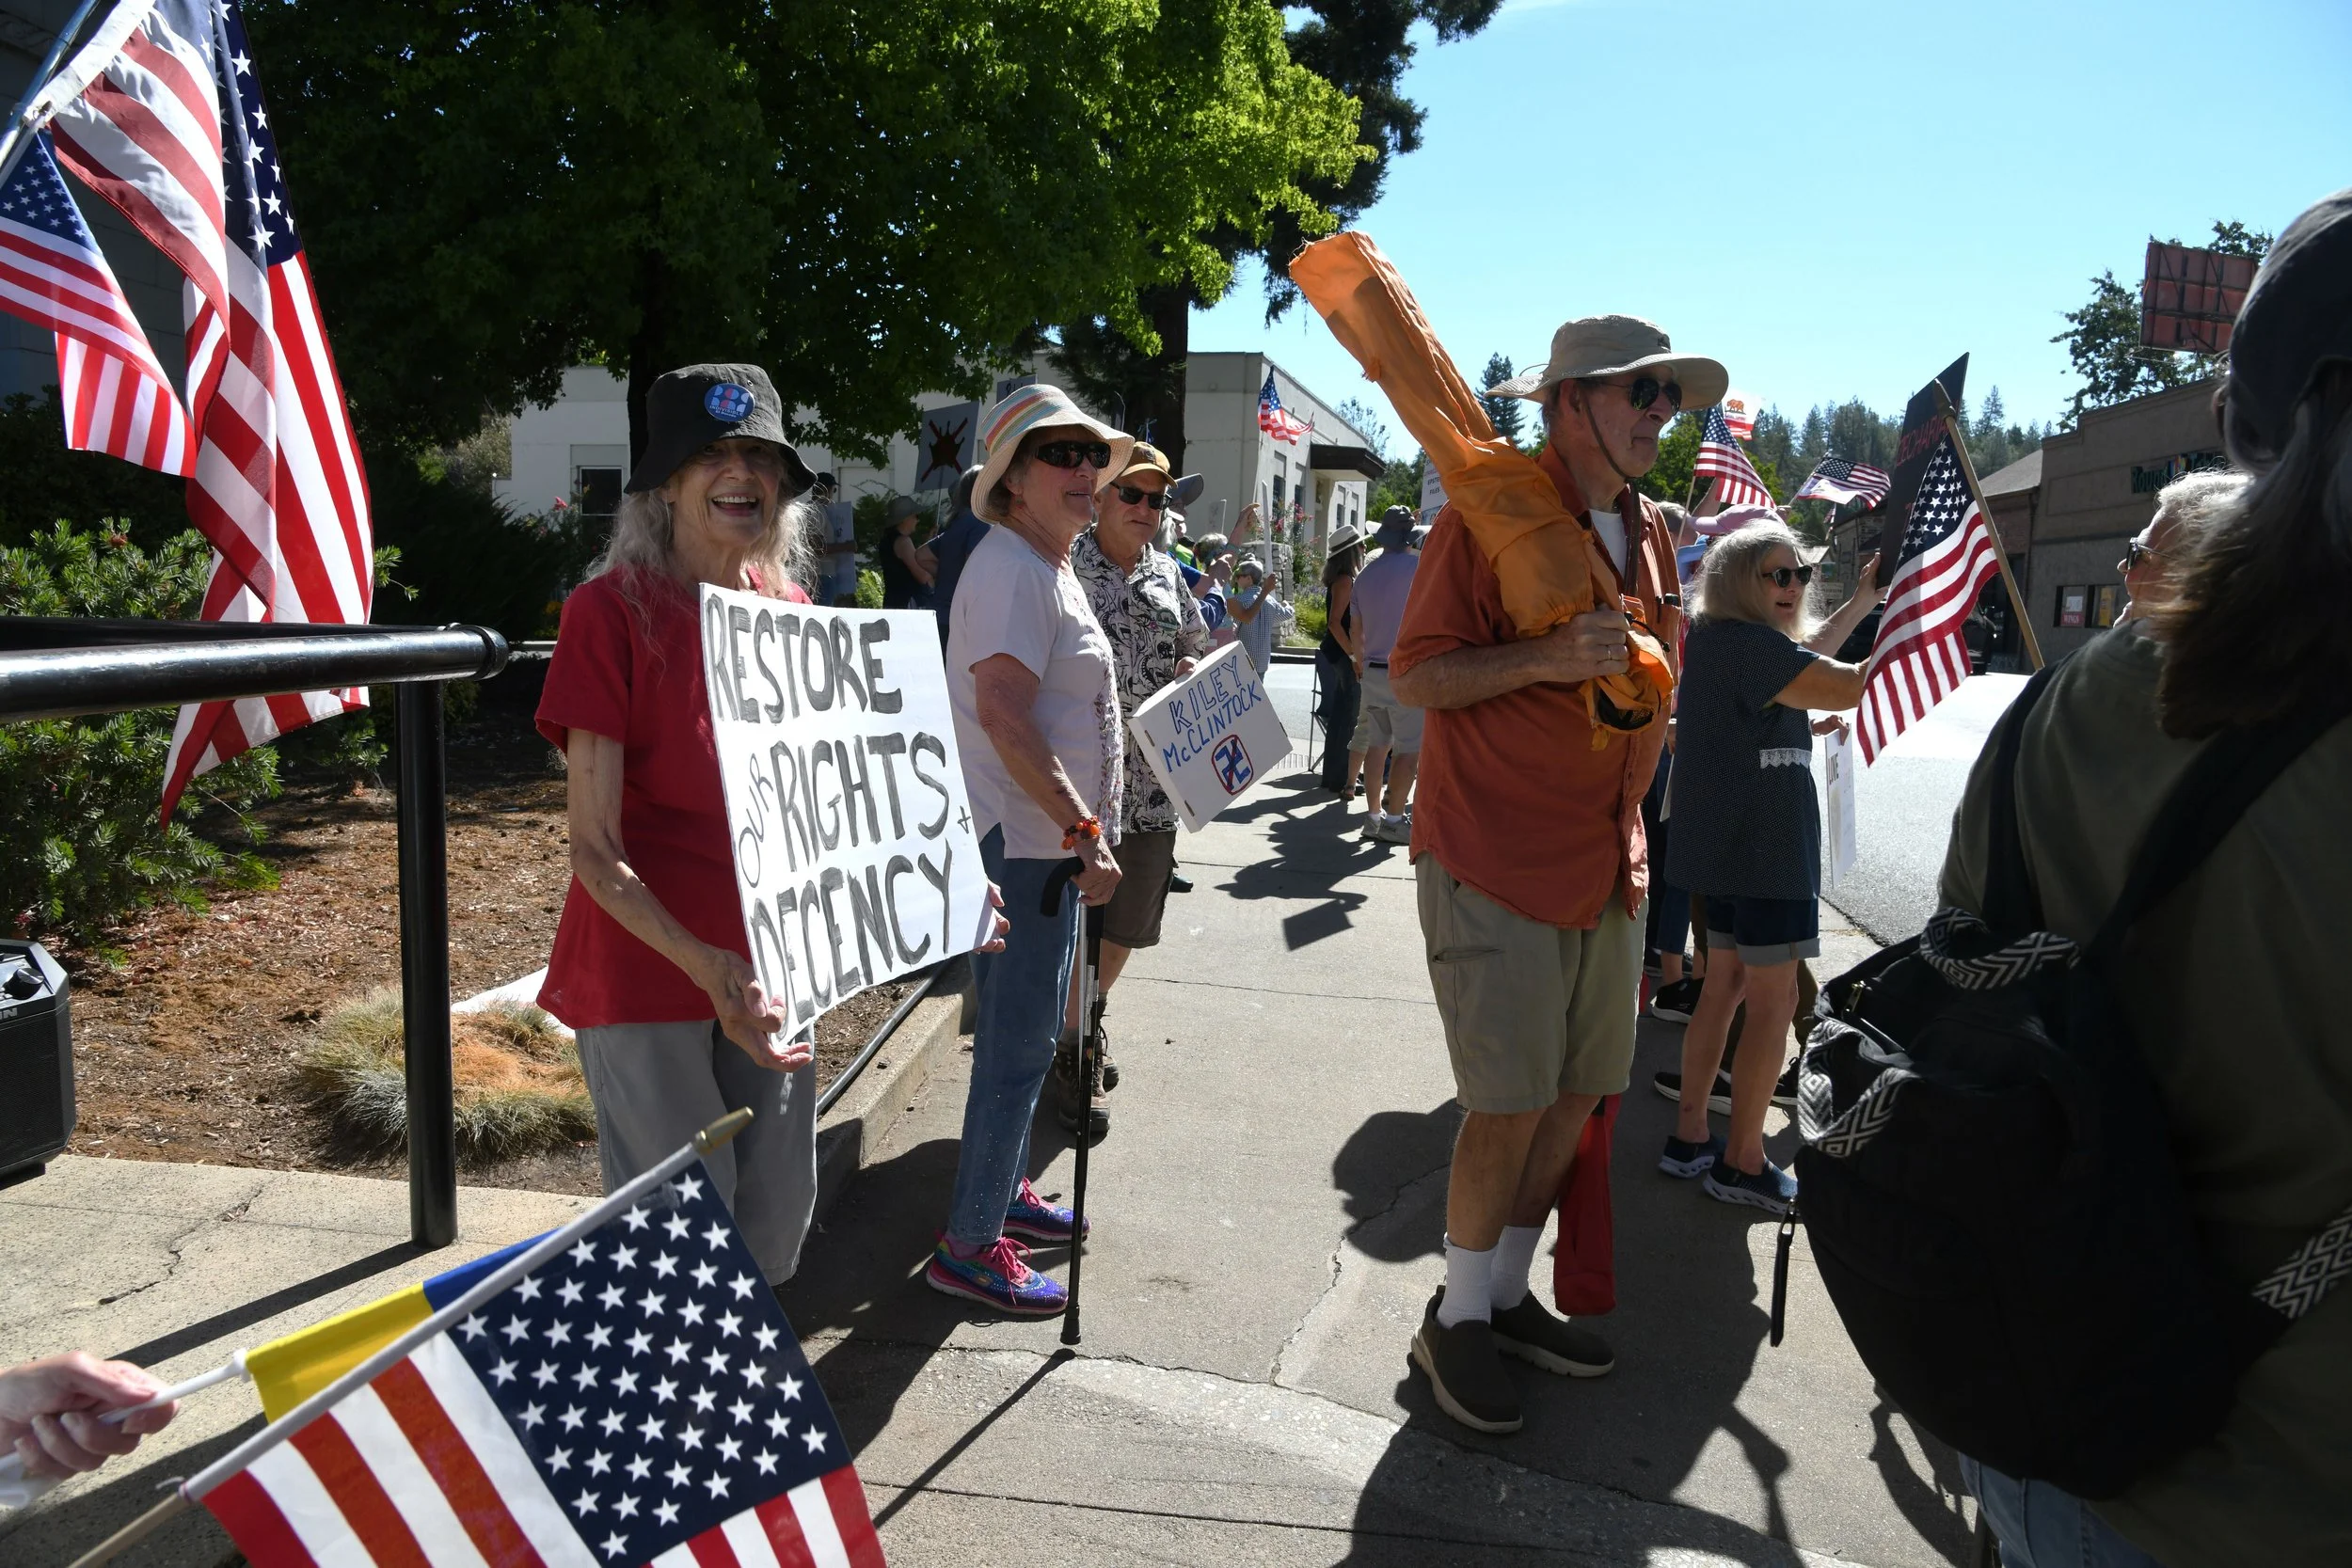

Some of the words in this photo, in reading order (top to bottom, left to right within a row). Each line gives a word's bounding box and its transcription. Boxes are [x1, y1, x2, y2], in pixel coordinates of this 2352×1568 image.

[707, 594, 902, 723] RESTORE
[1168, 655, 1242, 735] KILEY
[1163, 680, 1262, 773] McCLINTOCK
[739, 753, 773, 888] OUR
[771, 732, 950, 873] RIGHTS
[750, 838, 953, 1039] DECENCY
